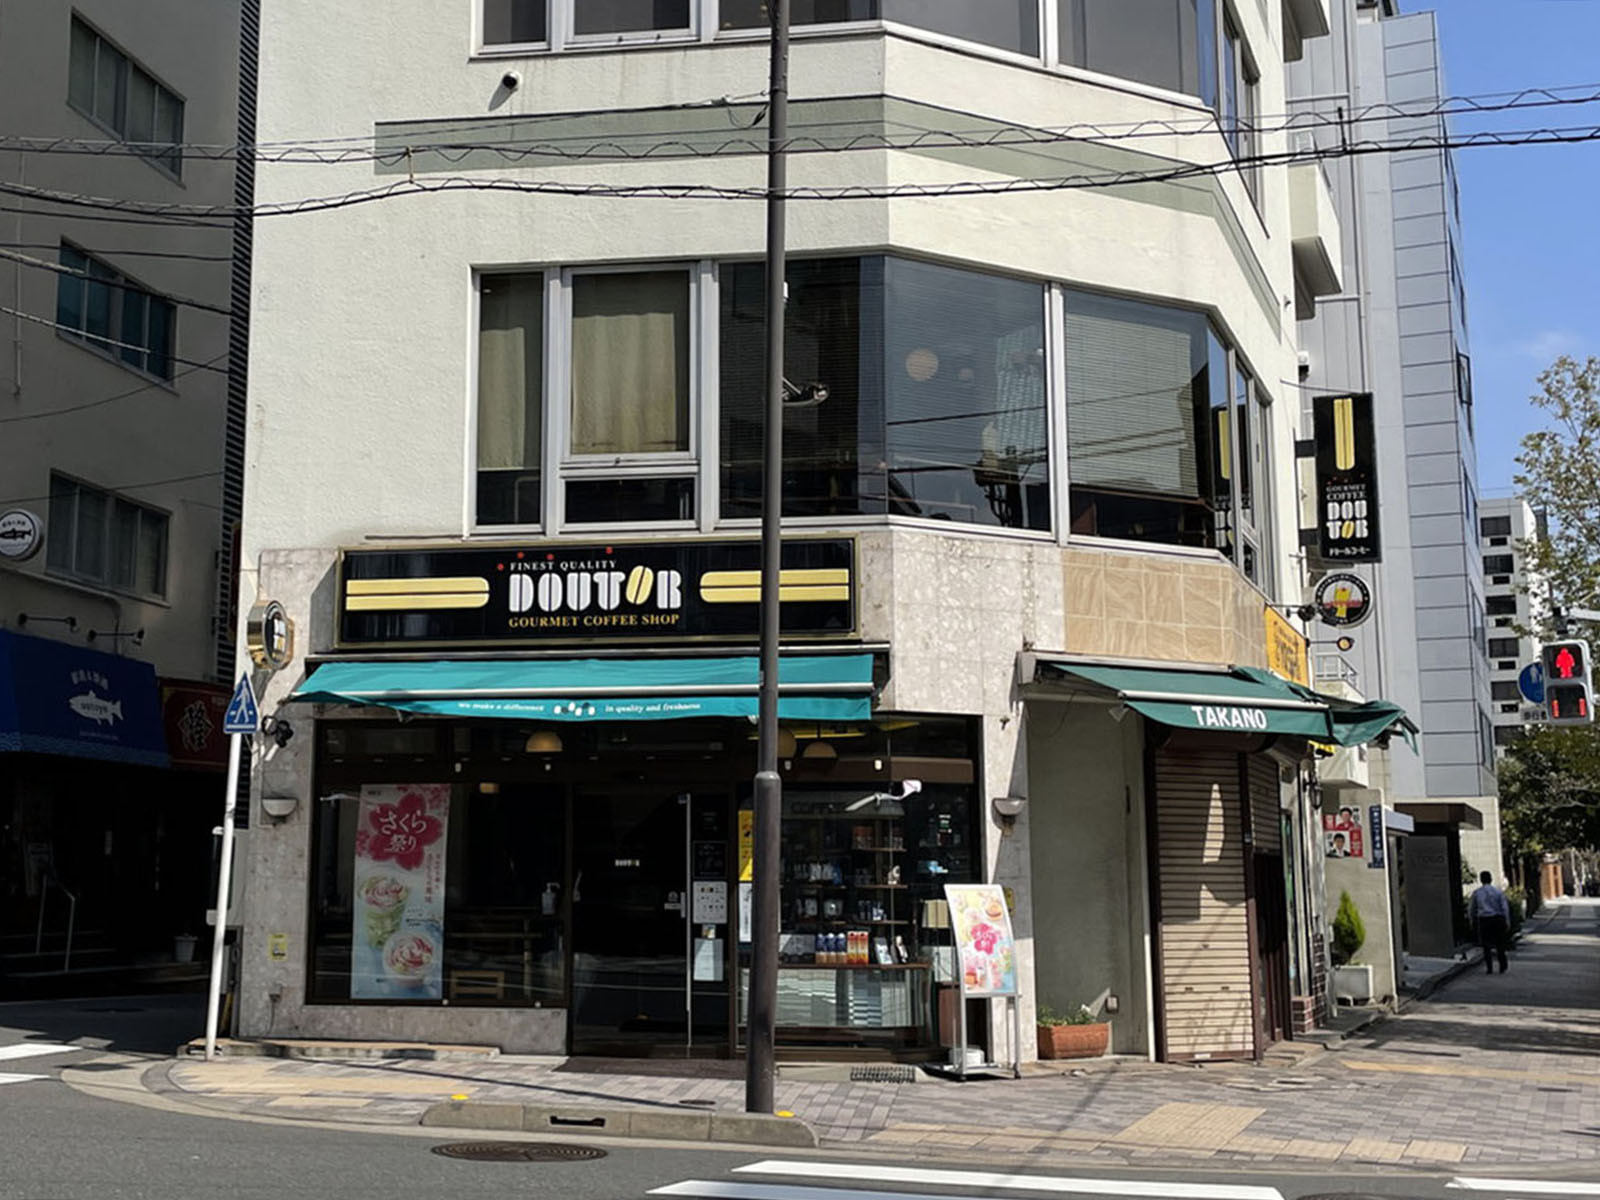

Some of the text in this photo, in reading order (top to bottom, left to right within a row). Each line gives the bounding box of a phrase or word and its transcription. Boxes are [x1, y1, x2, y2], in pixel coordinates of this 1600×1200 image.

[1326, 491, 1367, 500] COFFEE
[1327, 500, 1367, 520] DOU
[510, 560, 617, 571] FINEST QUALITY
[508, 565, 682, 612] DOUTOR
[508, 614, 680, 628] GOURMET COFFEE SHOP
[1191, 705, 1268, 729] TAKANO
[379, 809, 427, 835] さくら
[384, 834, 417, 855] 祭り
